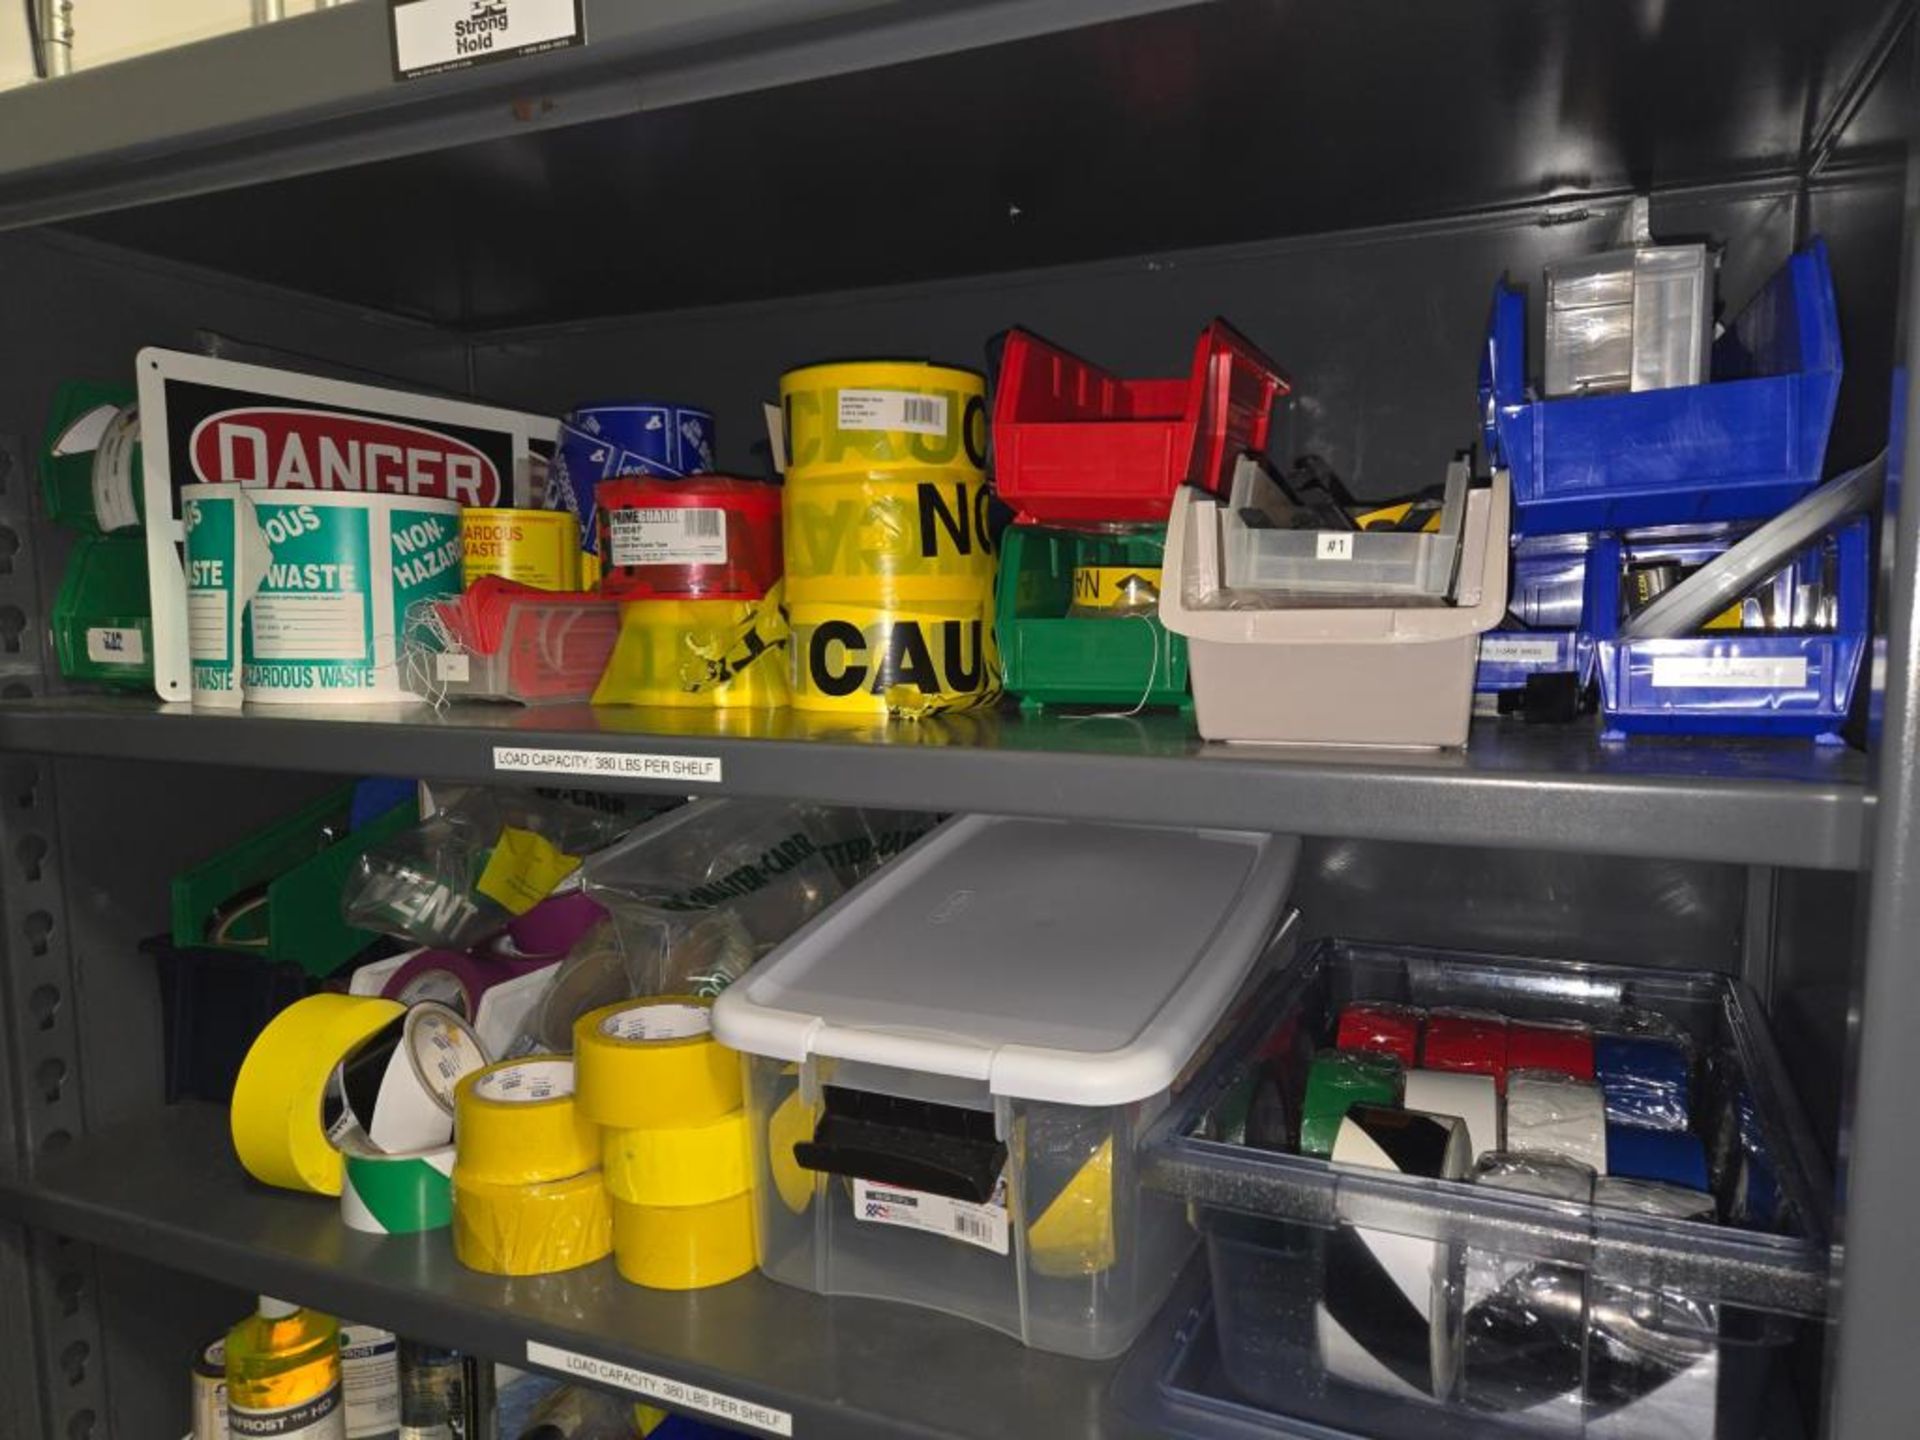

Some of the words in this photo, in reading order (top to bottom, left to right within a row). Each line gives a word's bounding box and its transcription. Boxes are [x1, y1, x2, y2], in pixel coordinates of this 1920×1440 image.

[455, 15, 508, 37] Strong
[456, 33, 493, 54] Hold
[218, 422, 484, 507] DANGER
[1326, 539, 1345, 553] #1
[267, 563, 356, 590] WASTE
[319, 667, 376, 688] WASTE
[498, 752, 530, 766] LOAD
[532, 754, 592, 769] CAPACITY:
[594, 756, 616, 771] 380
[618, 757, 642, 772] LBS
[644, 759, 670, 773] PER
[672, 761, 714, 776] SHELF
[566, 1355, 598, 1374] LOAD
[662, 1382, 684, 1400] 380
[685, 1388, 710, 1408] LBS
[712, 1396, 738, 1415] PER
[741, 1402, 782, 1427] SHELF
